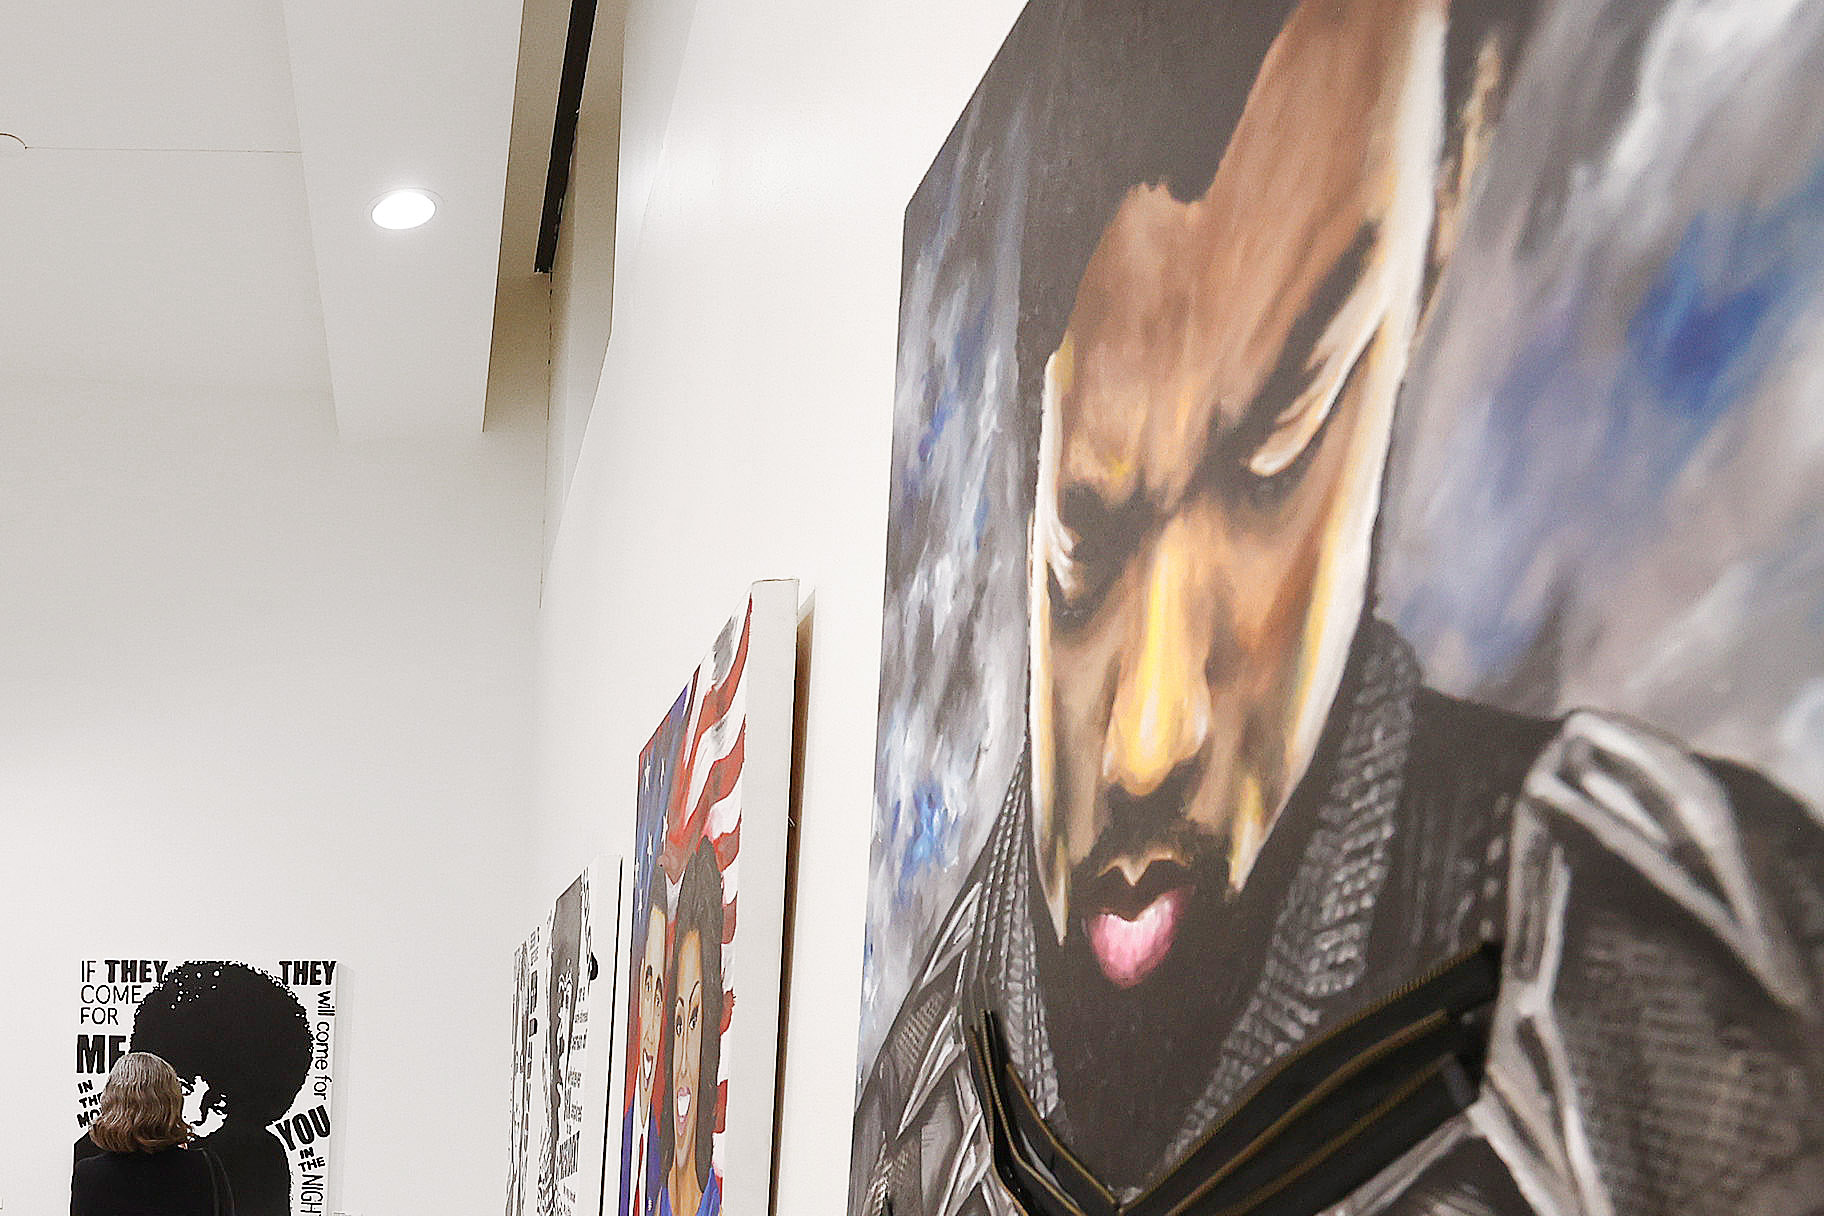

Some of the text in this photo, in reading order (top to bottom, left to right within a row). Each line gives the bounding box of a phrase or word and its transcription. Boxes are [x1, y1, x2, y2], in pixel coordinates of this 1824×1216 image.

[80, 959, 168, 983] IF THEY
[278, 960, 337, 986] THEY
[80, 984, 143, 1005] COME
[79, 1006, 119, 1026] FOR
[76, 1034, 127, 1074] ME
[313, 990, 336, 1101] will come for
[77, 1079, 94, 1094] IN
[275, 1104, 331, 1152] YOU
[298, 1156, 326, 1172] THE
[299, 1147, 315, 1160] IN
